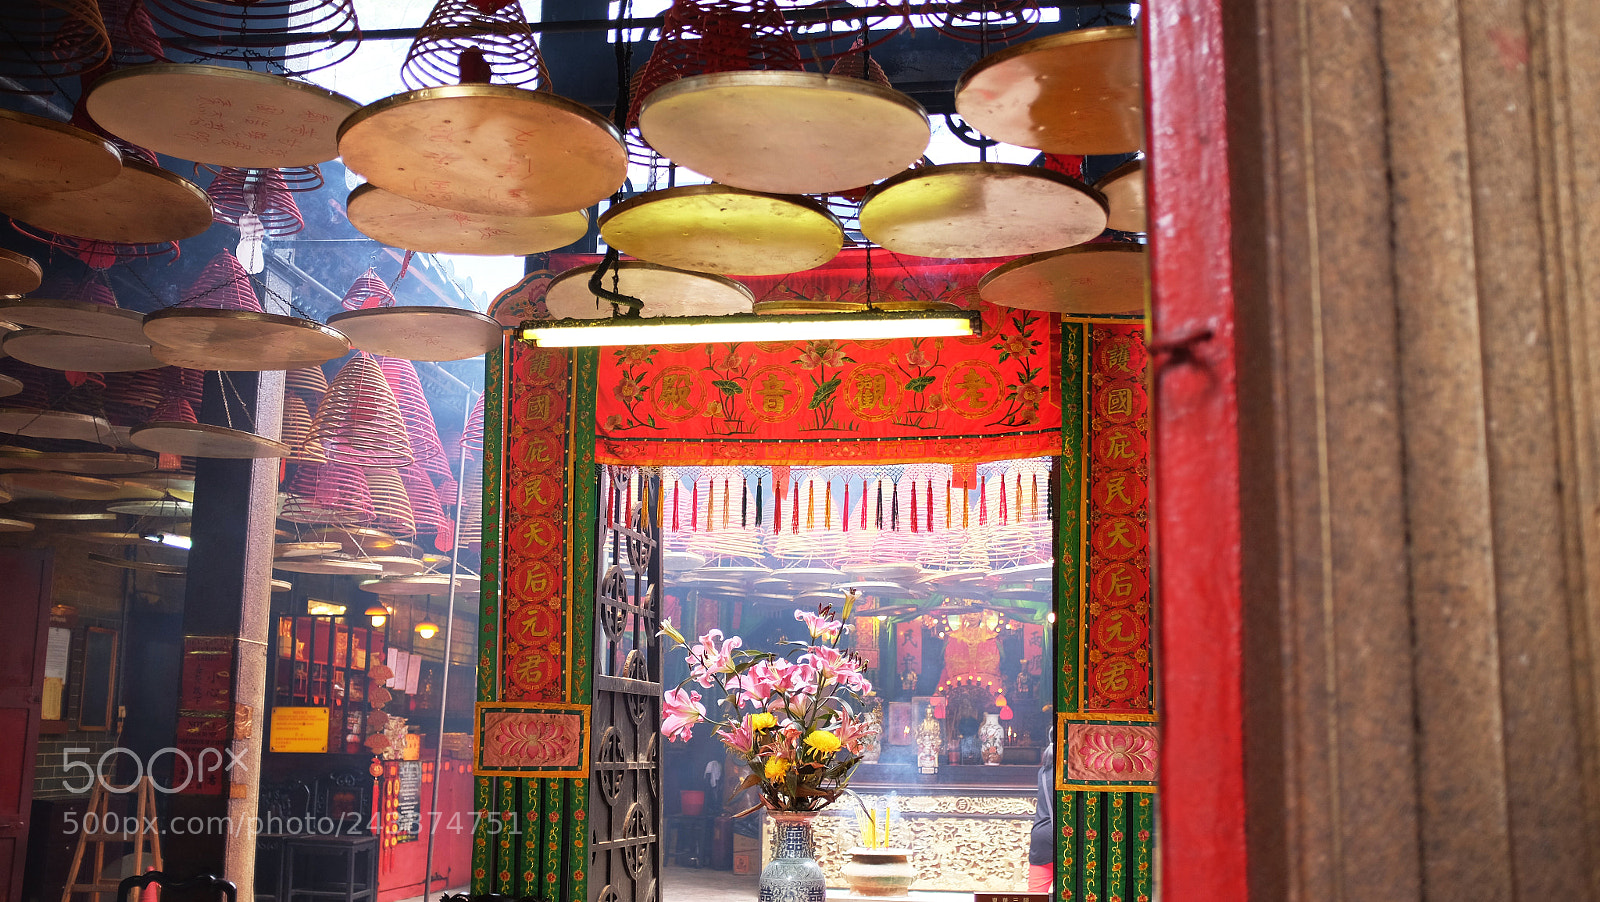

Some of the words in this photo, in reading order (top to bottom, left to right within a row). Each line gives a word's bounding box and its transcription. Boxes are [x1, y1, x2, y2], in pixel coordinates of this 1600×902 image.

[516, 348, 551, 684] 護國庇民天后元君
[1101, 343, 1136, 692] 護國庇民天后元君
